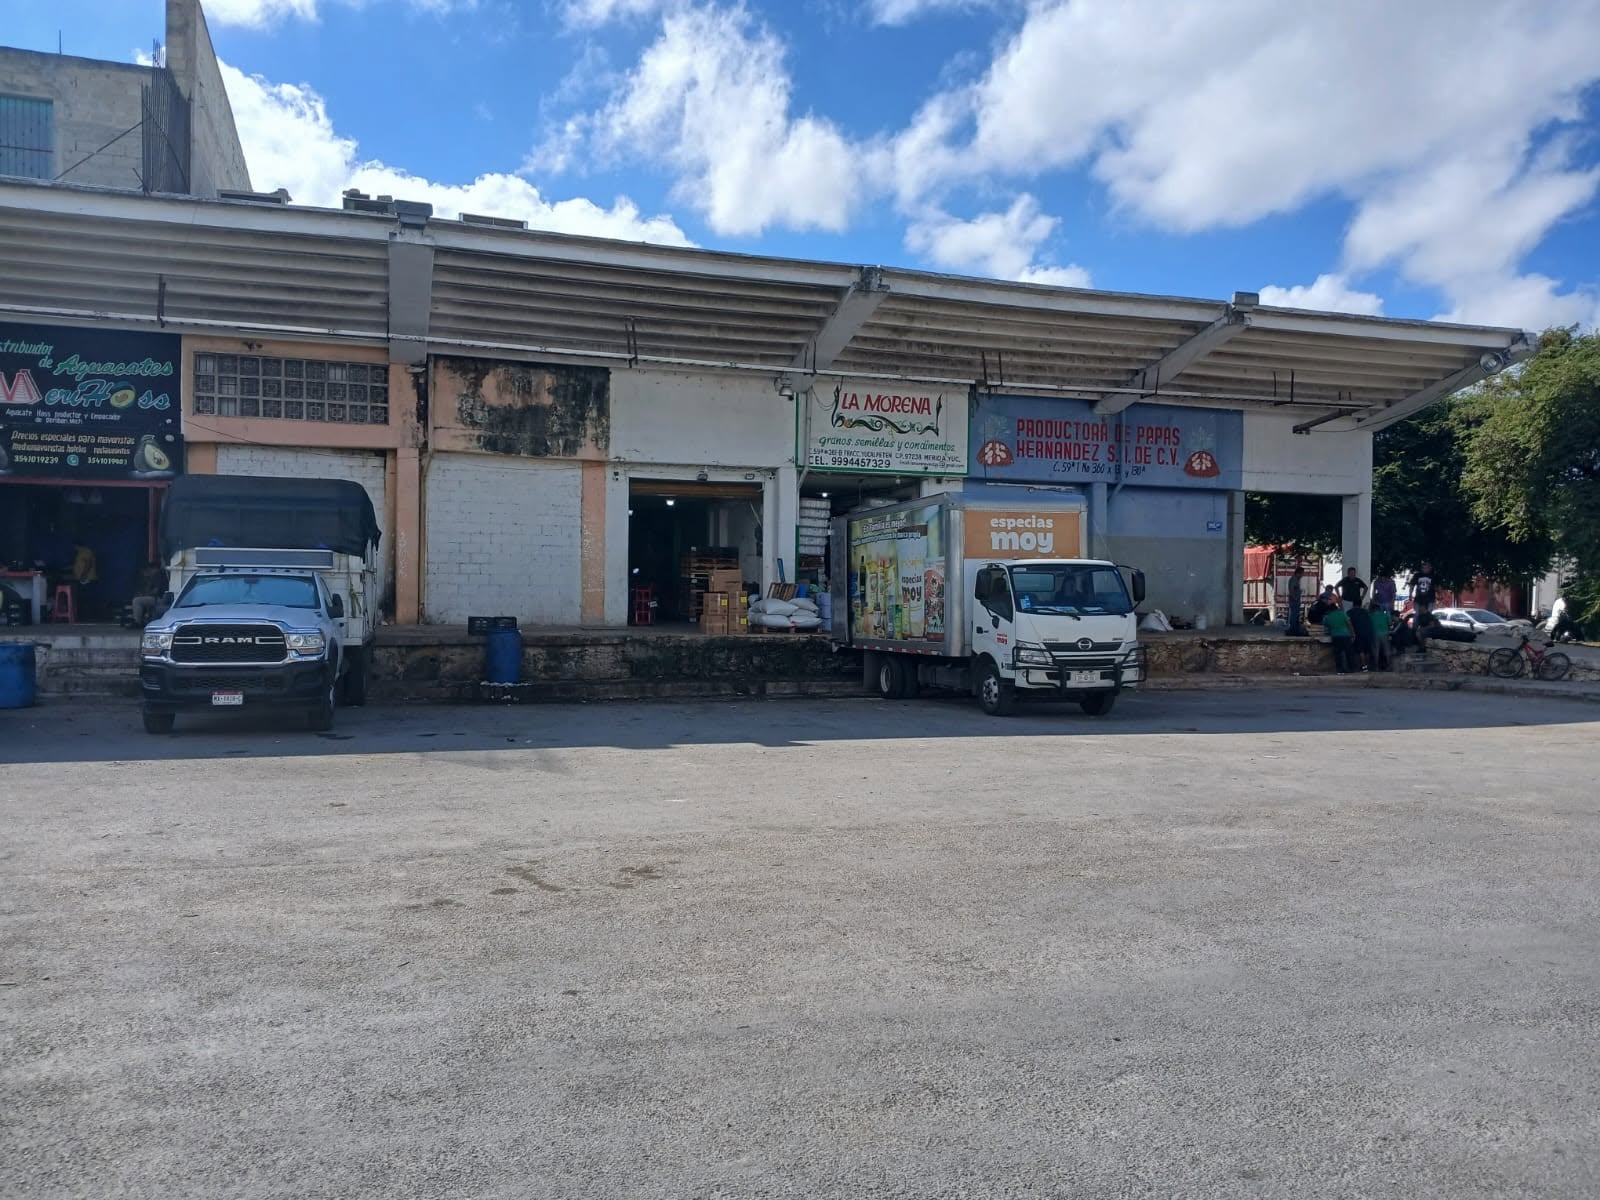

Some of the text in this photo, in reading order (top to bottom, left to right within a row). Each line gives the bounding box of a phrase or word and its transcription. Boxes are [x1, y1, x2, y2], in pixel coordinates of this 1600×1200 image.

[38, 354, 174, 381] de Aguacates
[841, 392, 932, 415] LA MORENA
[11, 431, 38, 441] Precios
[40, 432, 76, 442] especiales
[78, 435, 96, 443] para
[1016, 418, 1108, 442] PRODUCTORA
[1136, 426, 1181, 446] PAPAS
[855, 437, 895, 449] semillas
[897, 441, 903, 450] y
[904, 440, 956, 452] condimentos
[1016, 440, 1100, 462] HERNANDEZ
[1135, 446, 1152, 465] DE
[831, 456, 892, 468] 9994457329
[991, 515, 1054, 530] especias
[991, 531, 1054, 554] moy
[205, 636, 253, 644] RAM
